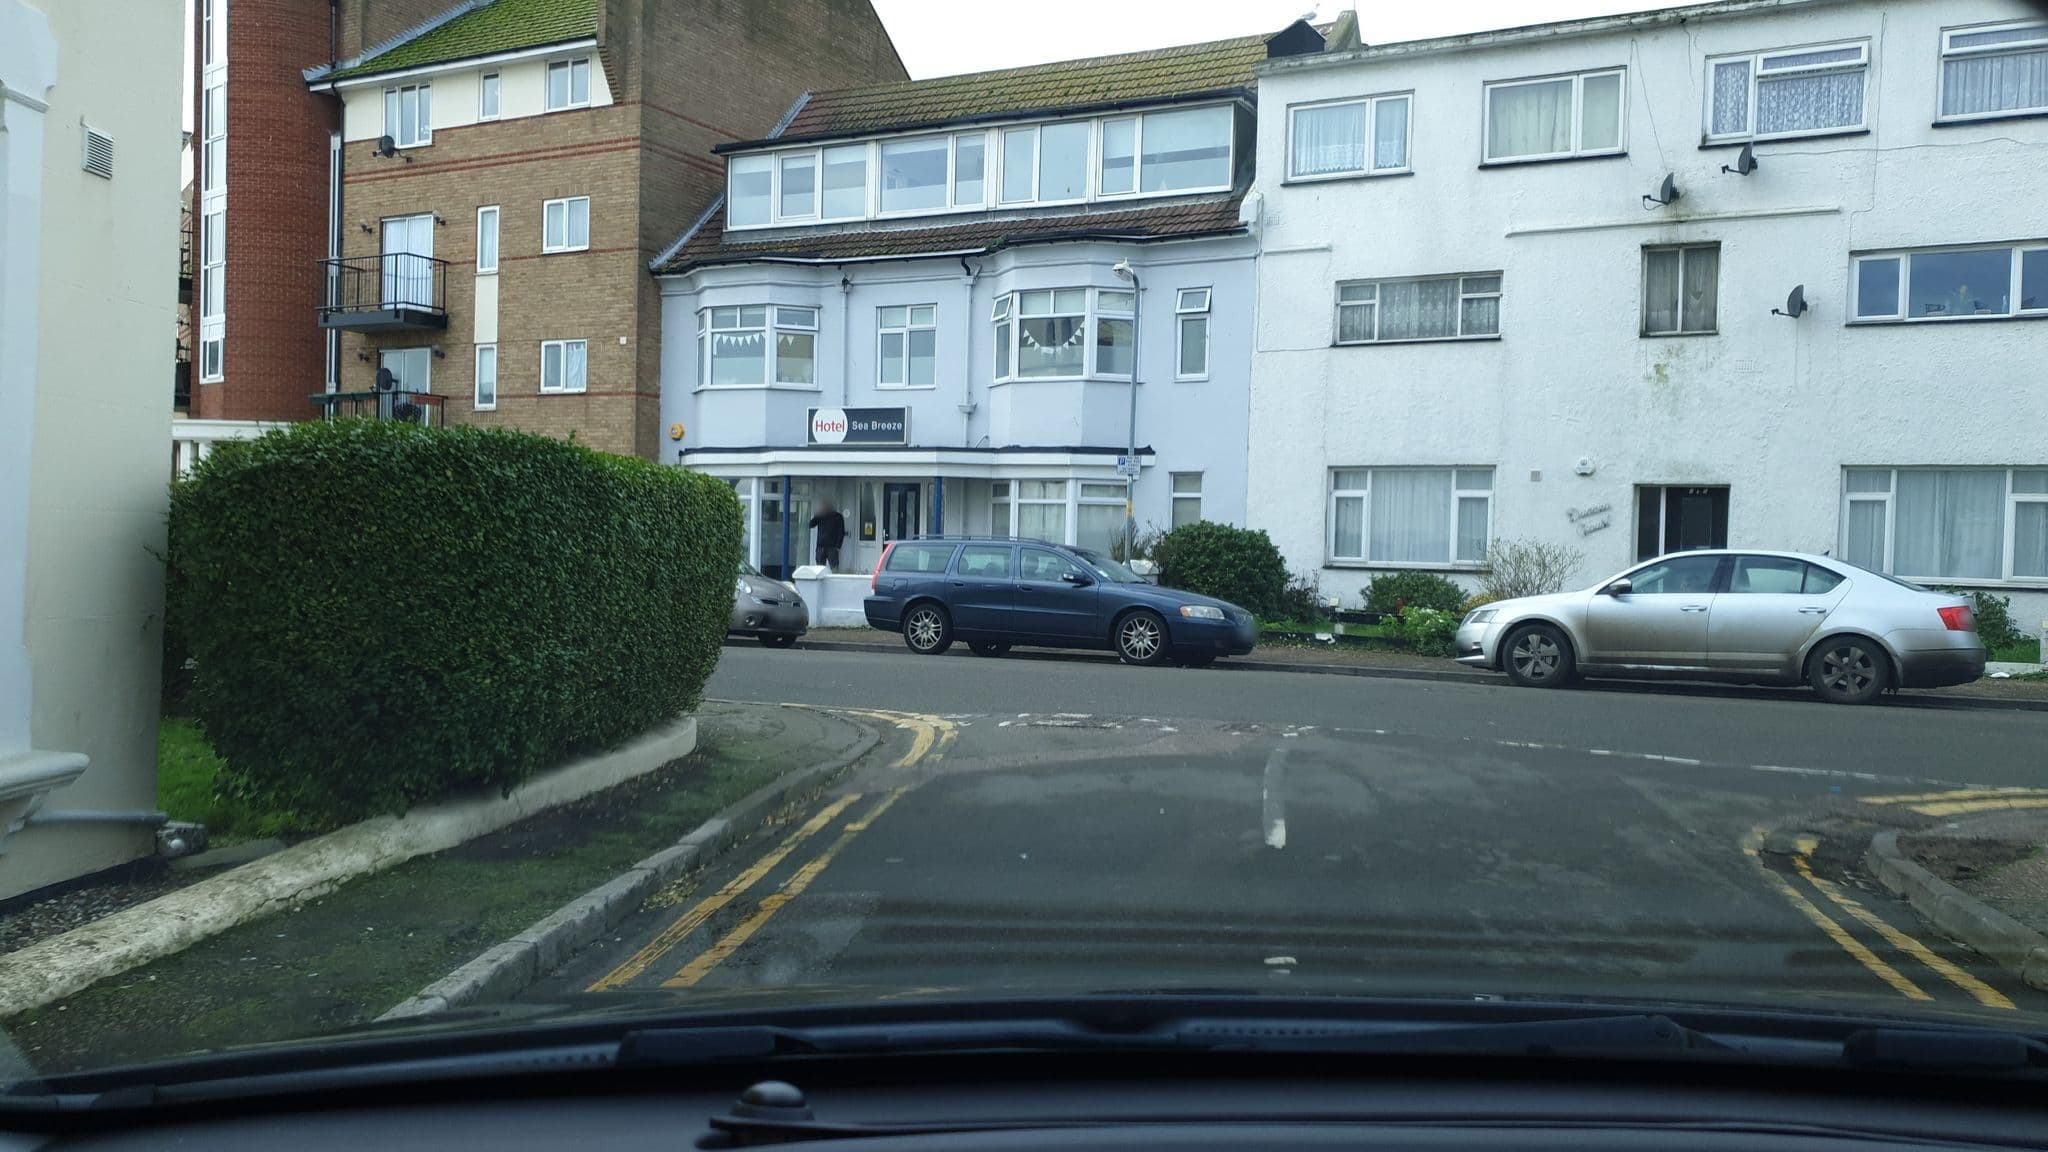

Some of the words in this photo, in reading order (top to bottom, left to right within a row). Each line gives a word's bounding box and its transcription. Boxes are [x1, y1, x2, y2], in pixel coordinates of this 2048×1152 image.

[815, 420, 845, 432] Hotel
[852, 421, 869, 431] Sea
[871, 421, 903, 431] Breeze
